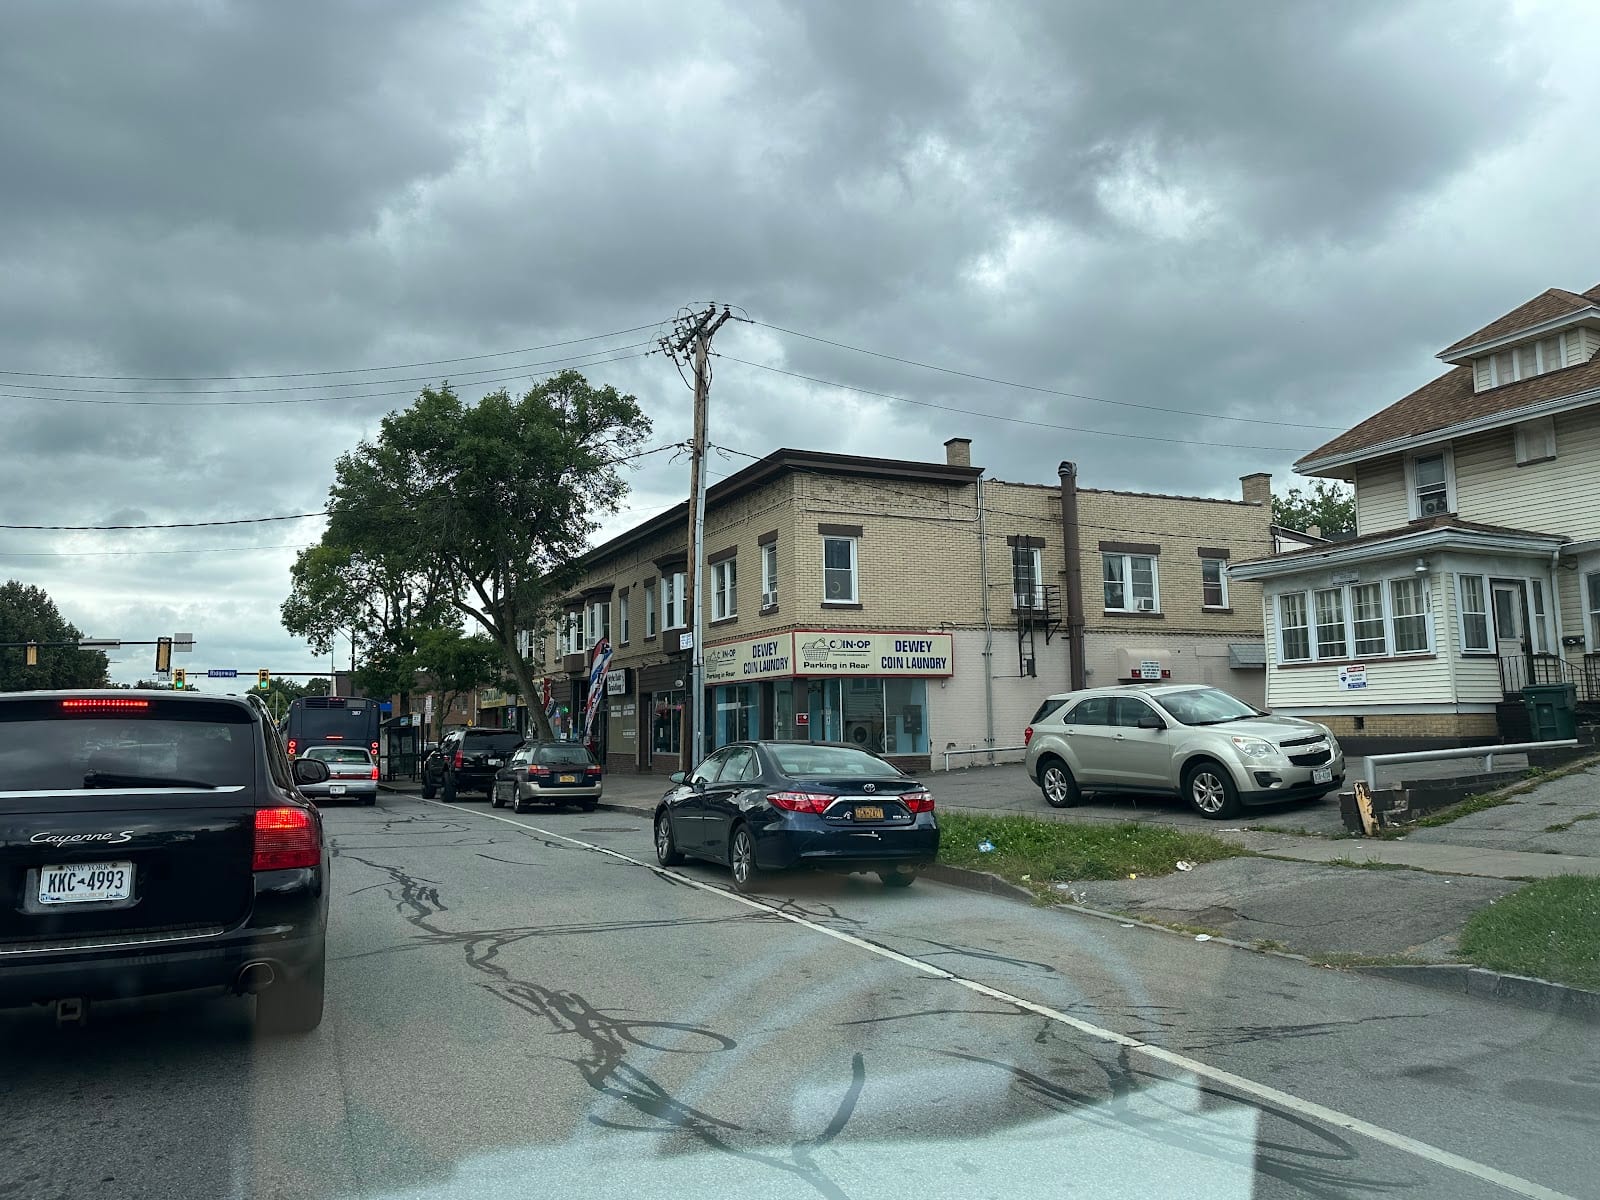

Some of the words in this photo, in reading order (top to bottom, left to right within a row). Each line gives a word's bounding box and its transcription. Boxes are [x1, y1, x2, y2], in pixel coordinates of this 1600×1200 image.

[752, 641, 778, 659] DEWEY
[895, 640, 932, 653] DEWEY
[743, 660, 758, 675] COIN
[759, 656, 789, 673] LAUNDRY
[803, 661, 838, 670] Parking
[839, 661, 848, 669] in
[849, 661, 870, 669] Rear
[881, 656, 904, 669] COIN
[905, 656, 947, 669] LAUNDRY
[30, 832, 113, 847] Cayenne
[107, 830, 134, 844] S
[65, 864, 85, 872] NEW
[87, 863, 110, 871] YORK
